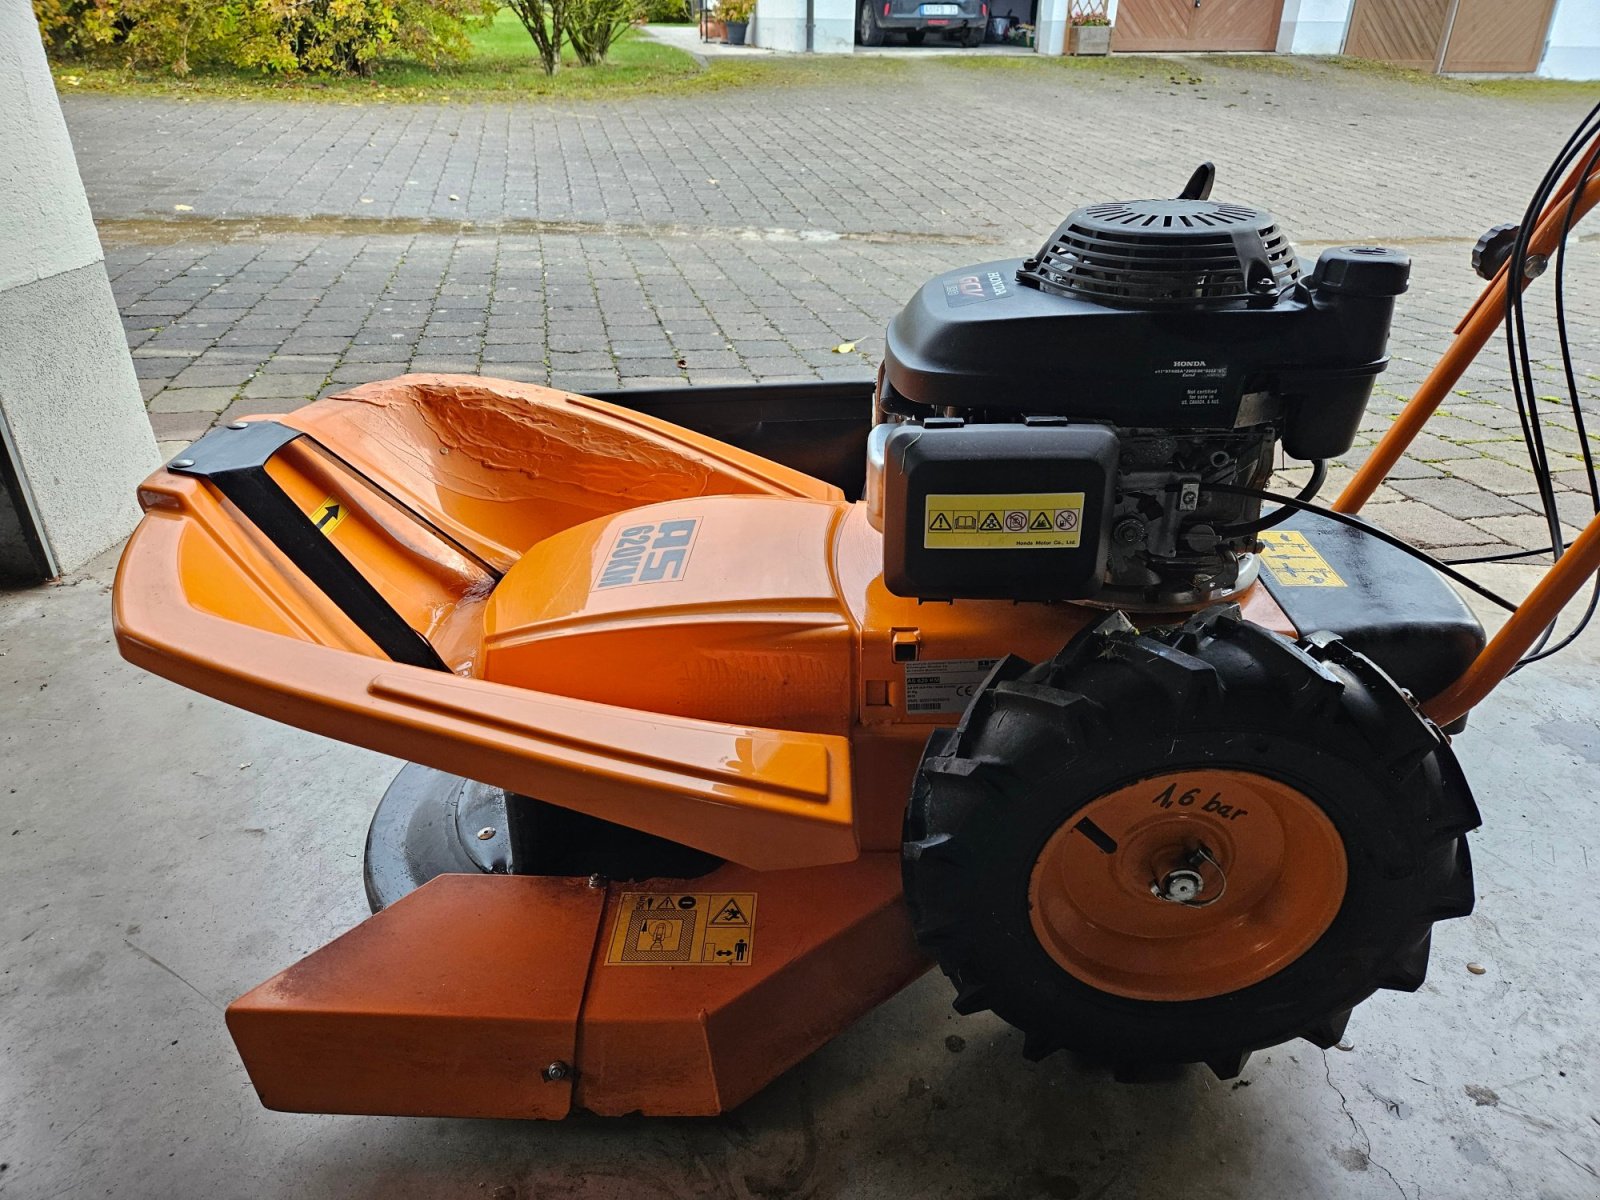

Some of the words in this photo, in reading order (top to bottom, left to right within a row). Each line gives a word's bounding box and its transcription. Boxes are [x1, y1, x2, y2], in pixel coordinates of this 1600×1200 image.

[960, 276, 985, 297] GCV
[987, 271, 1007, 296] HONDA
[598, 525, 655, 588] 620KM
[639, 520, 697, 581] AS
[1152, 782, 1201, 809] 1,6
[1201, 792, 1248, 820] bar
